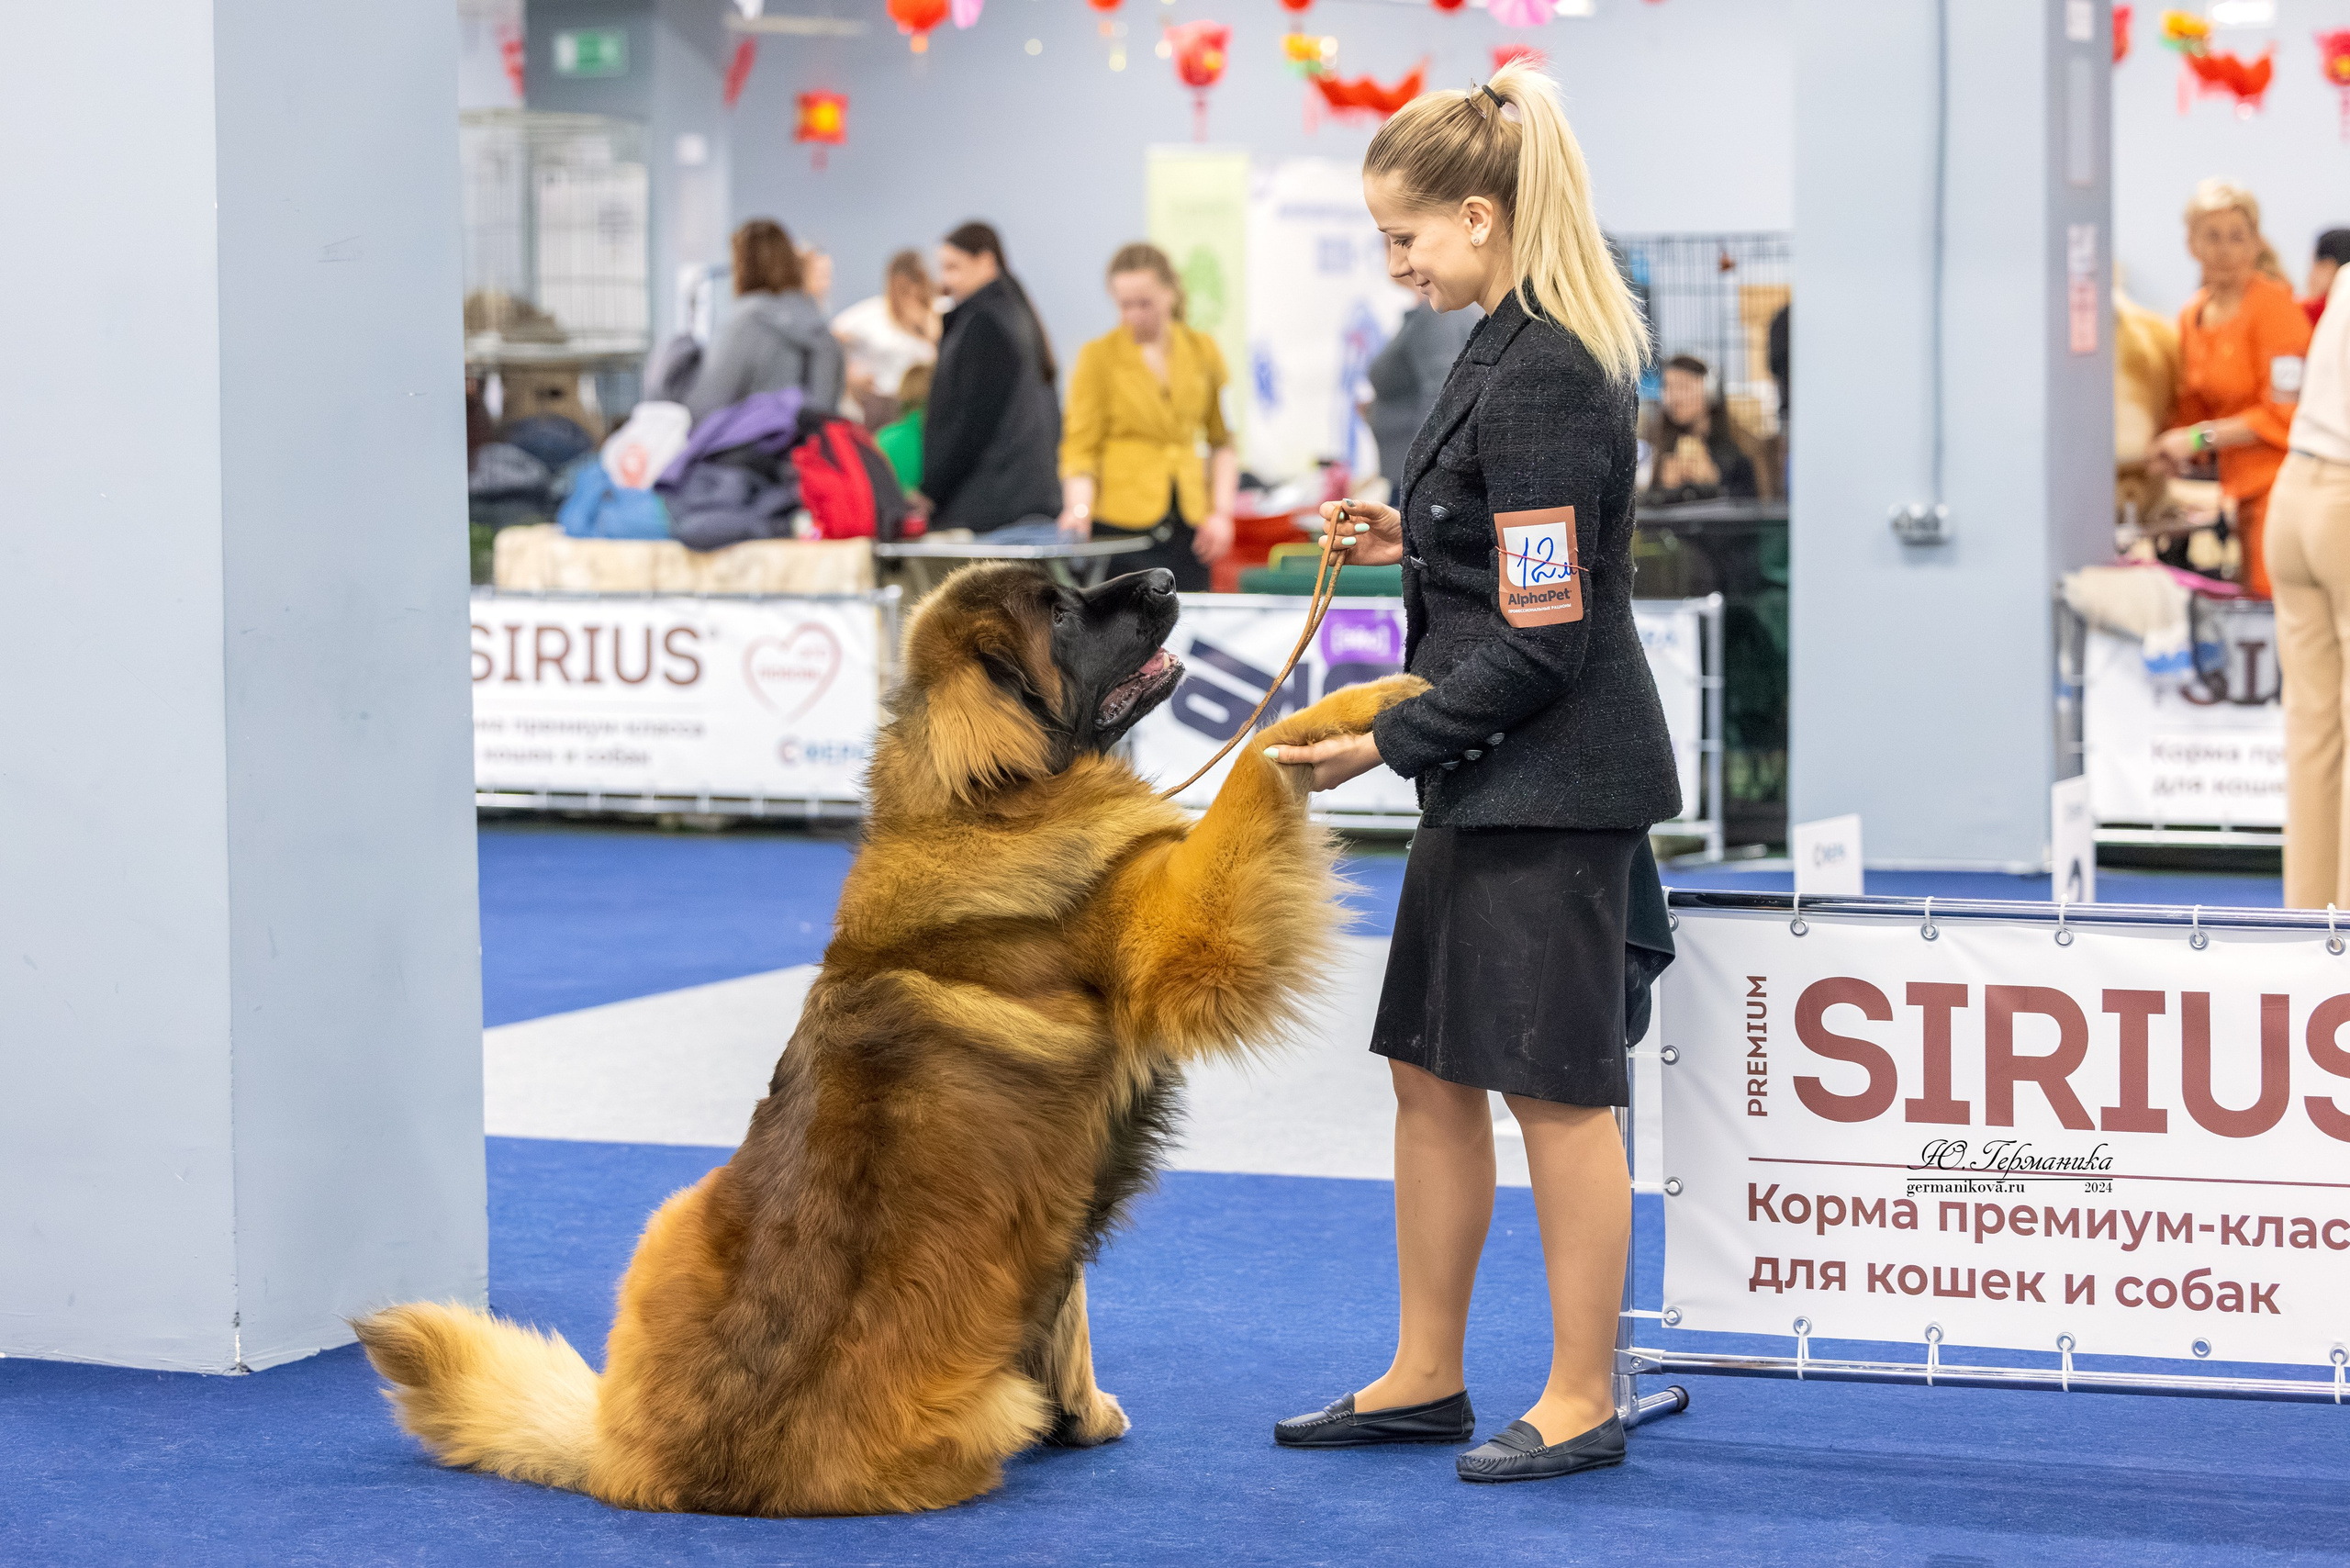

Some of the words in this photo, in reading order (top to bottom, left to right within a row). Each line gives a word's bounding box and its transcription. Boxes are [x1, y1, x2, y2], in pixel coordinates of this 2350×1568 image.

[1507, 588, 1570, 607] AlphaPet
[1747, 976, 1767, 1116] PREMIUM
[1749, 1183, 1918, 1236] Корма
[1749, 1257, 1846, 1294] для
[1868, 1263, 2045, 1303] кошек
[2065, 1274, 2095, 1305] и
[2116, 1268, 2280, 1315] собак
